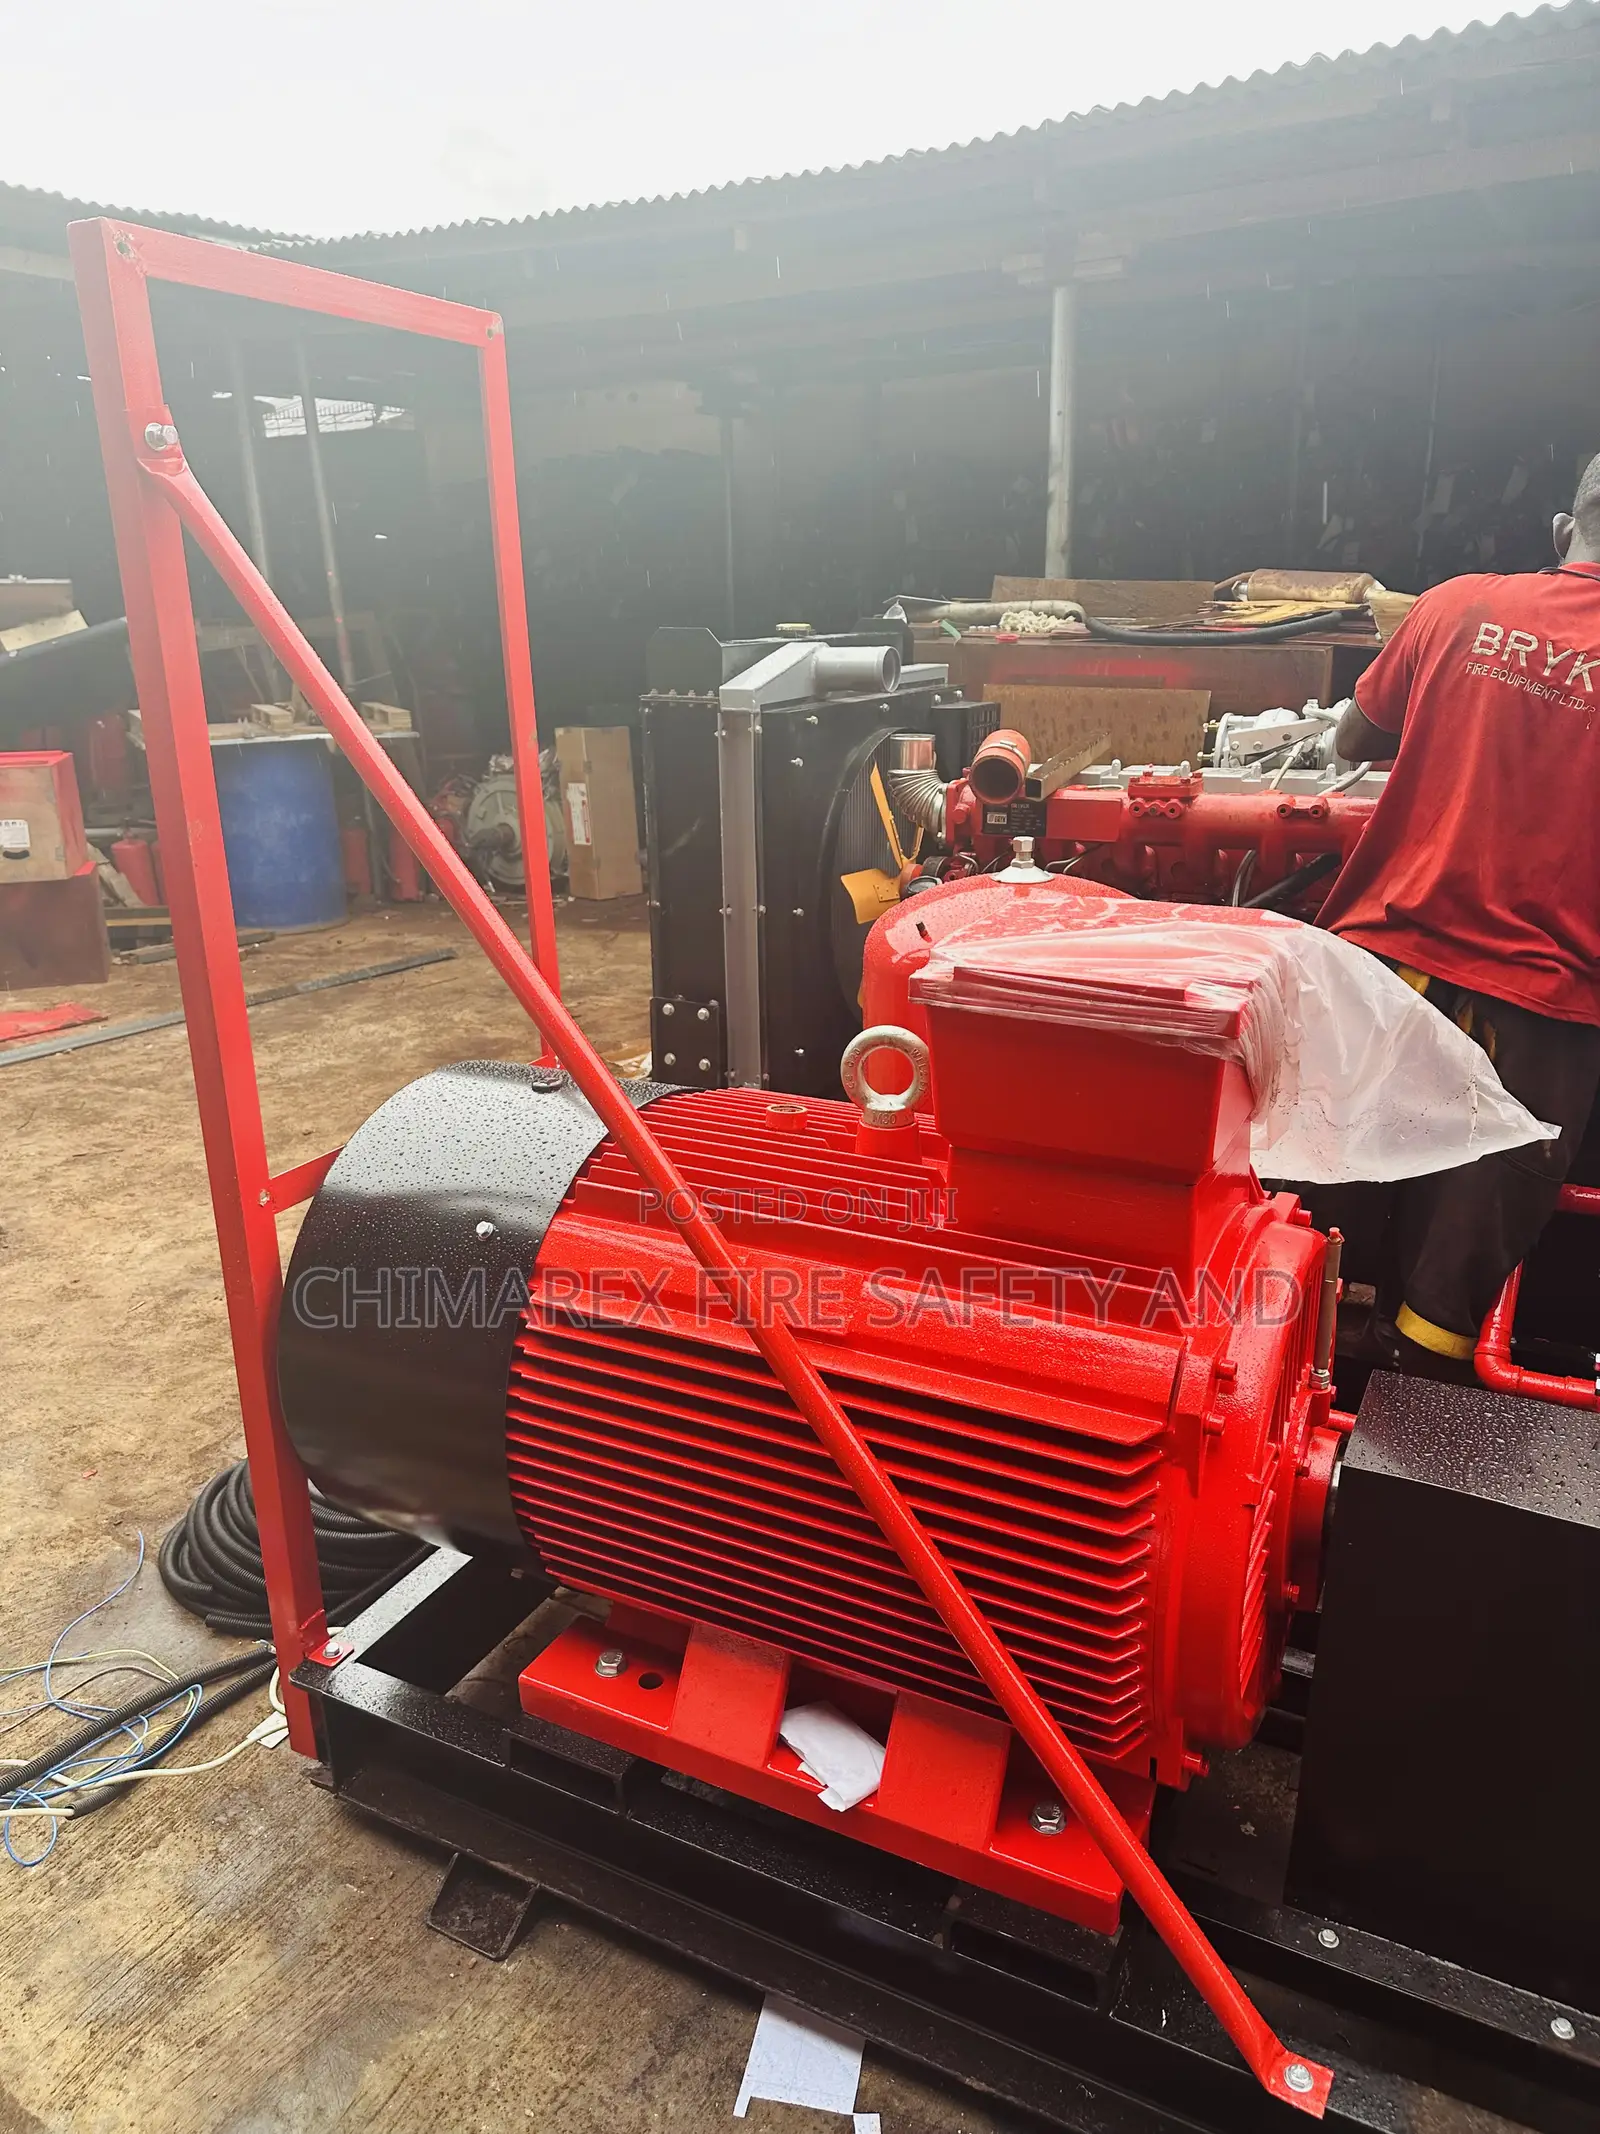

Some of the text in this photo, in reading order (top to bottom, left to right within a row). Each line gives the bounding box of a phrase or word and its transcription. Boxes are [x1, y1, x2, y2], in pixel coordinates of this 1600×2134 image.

[1465, 661, 1586, 710] FIRE EQUIPMENT LTD
[1471, 622, 1600, 692] BRYK
